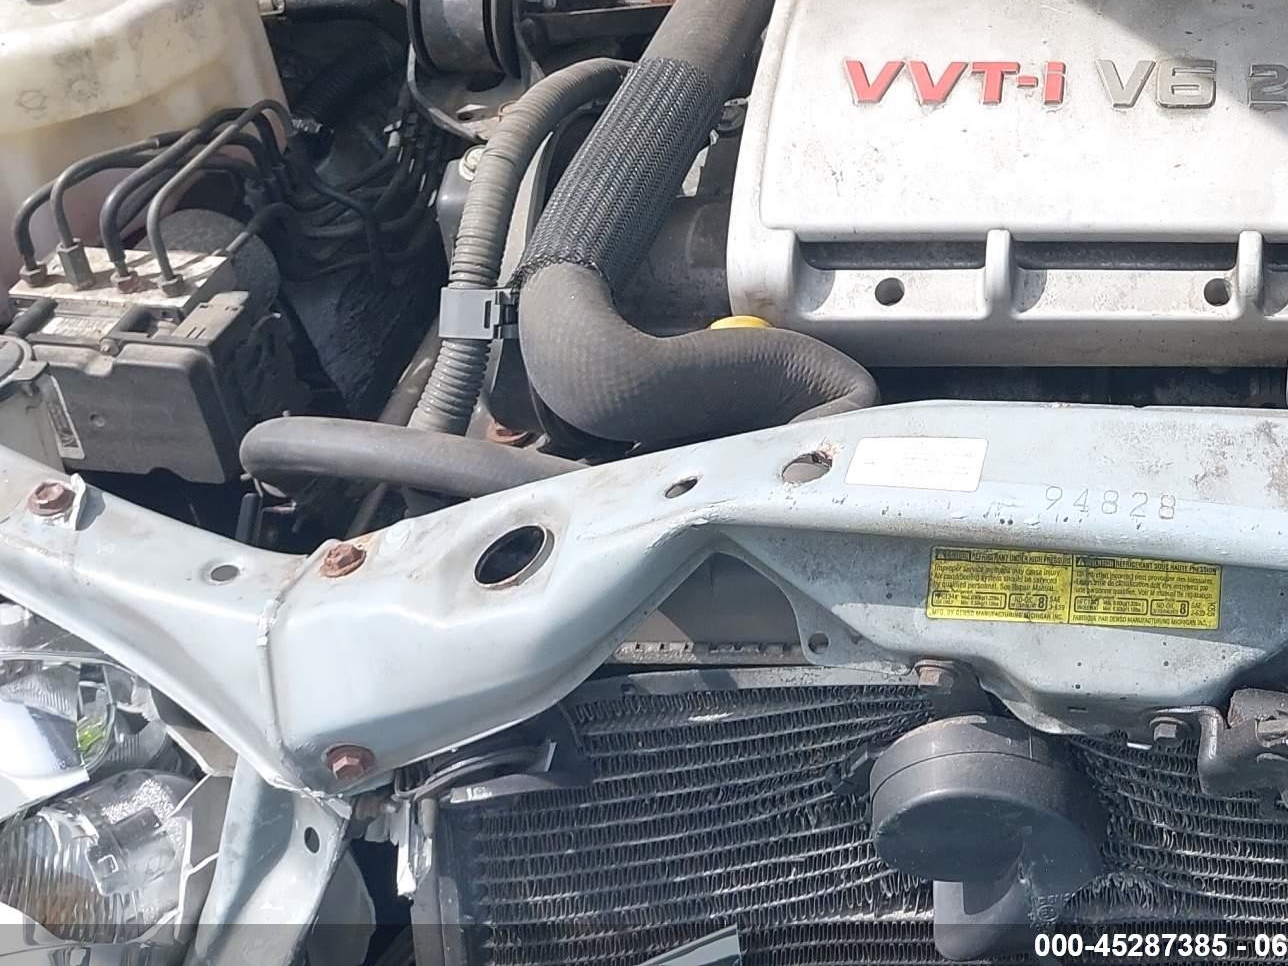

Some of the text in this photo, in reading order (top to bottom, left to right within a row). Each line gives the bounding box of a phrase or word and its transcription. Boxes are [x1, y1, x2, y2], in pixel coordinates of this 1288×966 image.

[843, 60, 1067, 106] VVT-i
[1097, 59, 1217, 109] V6
[1045, 486, 1177, 520] 94828
[1037, 597, 1045, 608] 8
[1179, 603, 1187, 614] 8
[976, 610, 1023, 619] MANUFACTURING
[1127, 616, 1171, 625] MANUFACTURING
